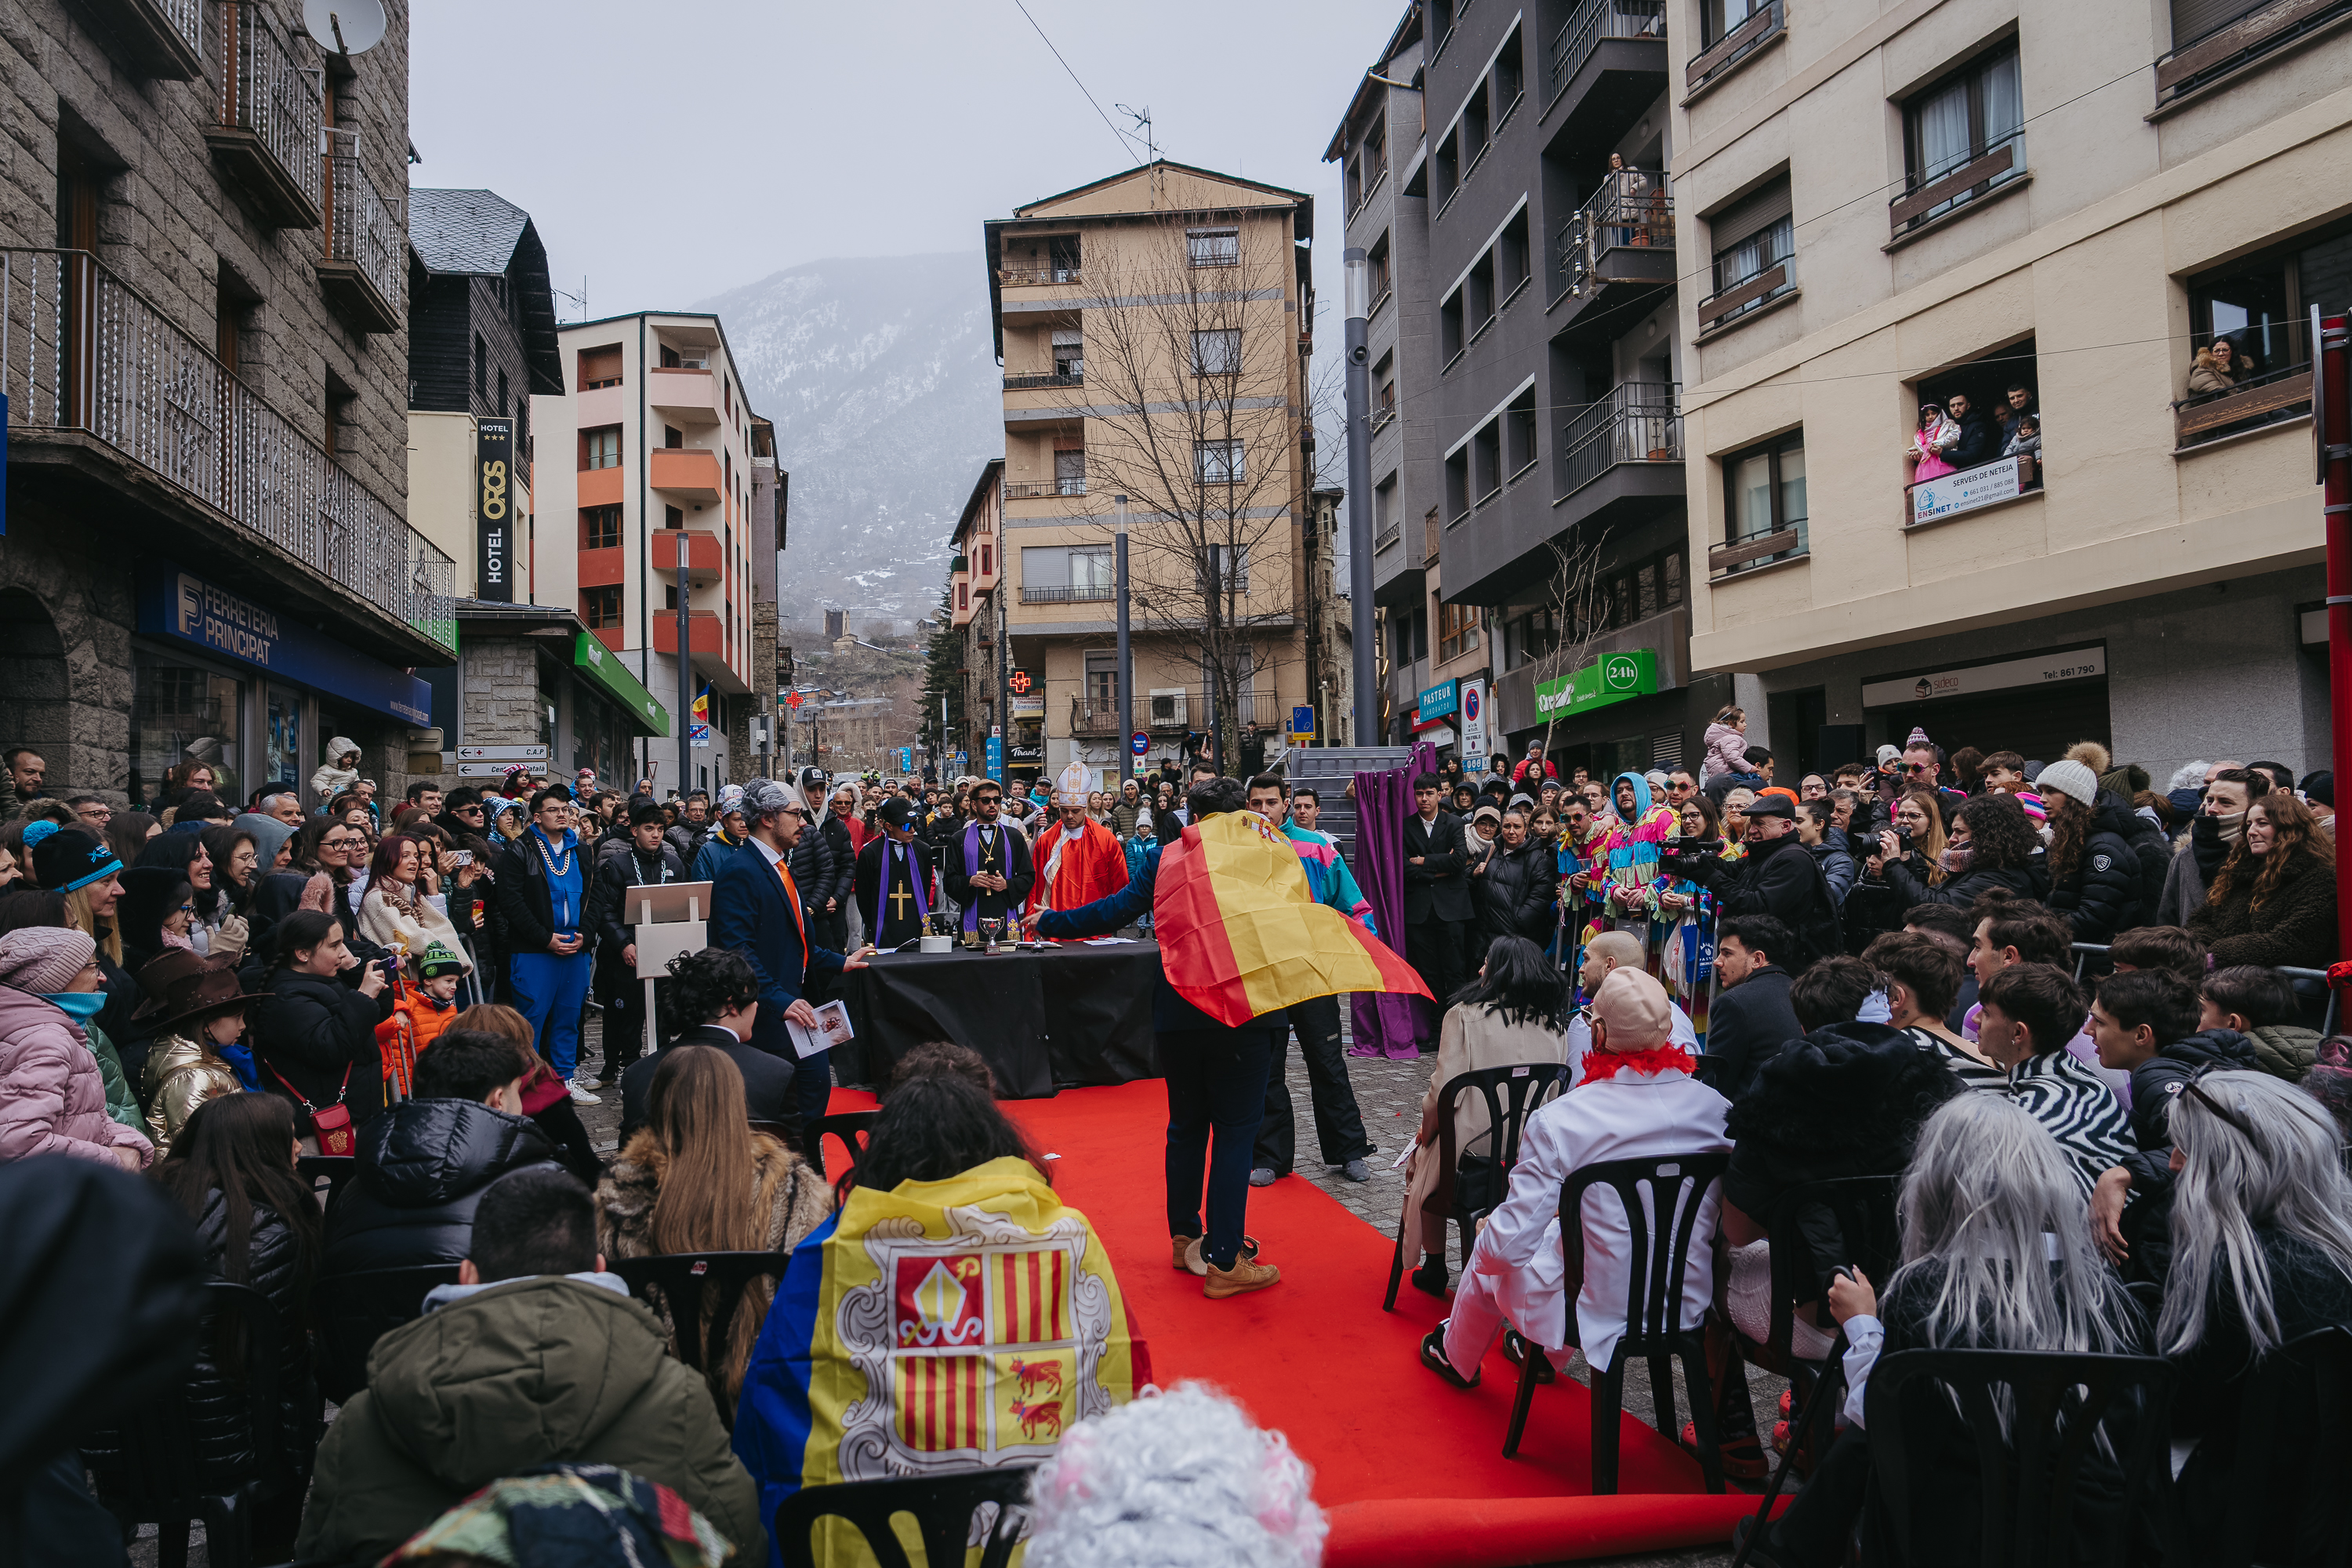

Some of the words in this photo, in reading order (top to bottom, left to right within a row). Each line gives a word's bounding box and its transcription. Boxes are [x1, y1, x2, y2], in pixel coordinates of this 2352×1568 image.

[1953, 474, 1978, 488] SERVEIS
[1979, 470, 1988, 480] DE
[1989, 464, 2014, 477] NETEJA
[483, 460, 506, 520] OROS
[1969, 487, 1980, 495] 661
[1980, 485, 1989, 493] 031
[1994, 481, 2004, 489] 885
[2004, 477, 2015, 486] 088
[1960, 488, 2015, 507] ensinet21@gmail.com
[1918, 503, 1951, 519] ENSINET
[488, 528, 502, 583] HOTEL
[205, 583, 279, 641] FERRETERIA
[205, 615, 270, 665] PRINCIPAT
[1610, 666, 1635, 678] 24h
[2043, 670, 2058, 680] Tel:
[2060, 667, 2075, 677] 861
[2078, 665, 2095, 675] 790
[1933, 677, 1958, 690] sideco
[1424, 686, 1451, 706] PASTEUR
[1424, 701, 1452, 717] LABORATORI
[1011, 746, 1036, 757] Tirant
